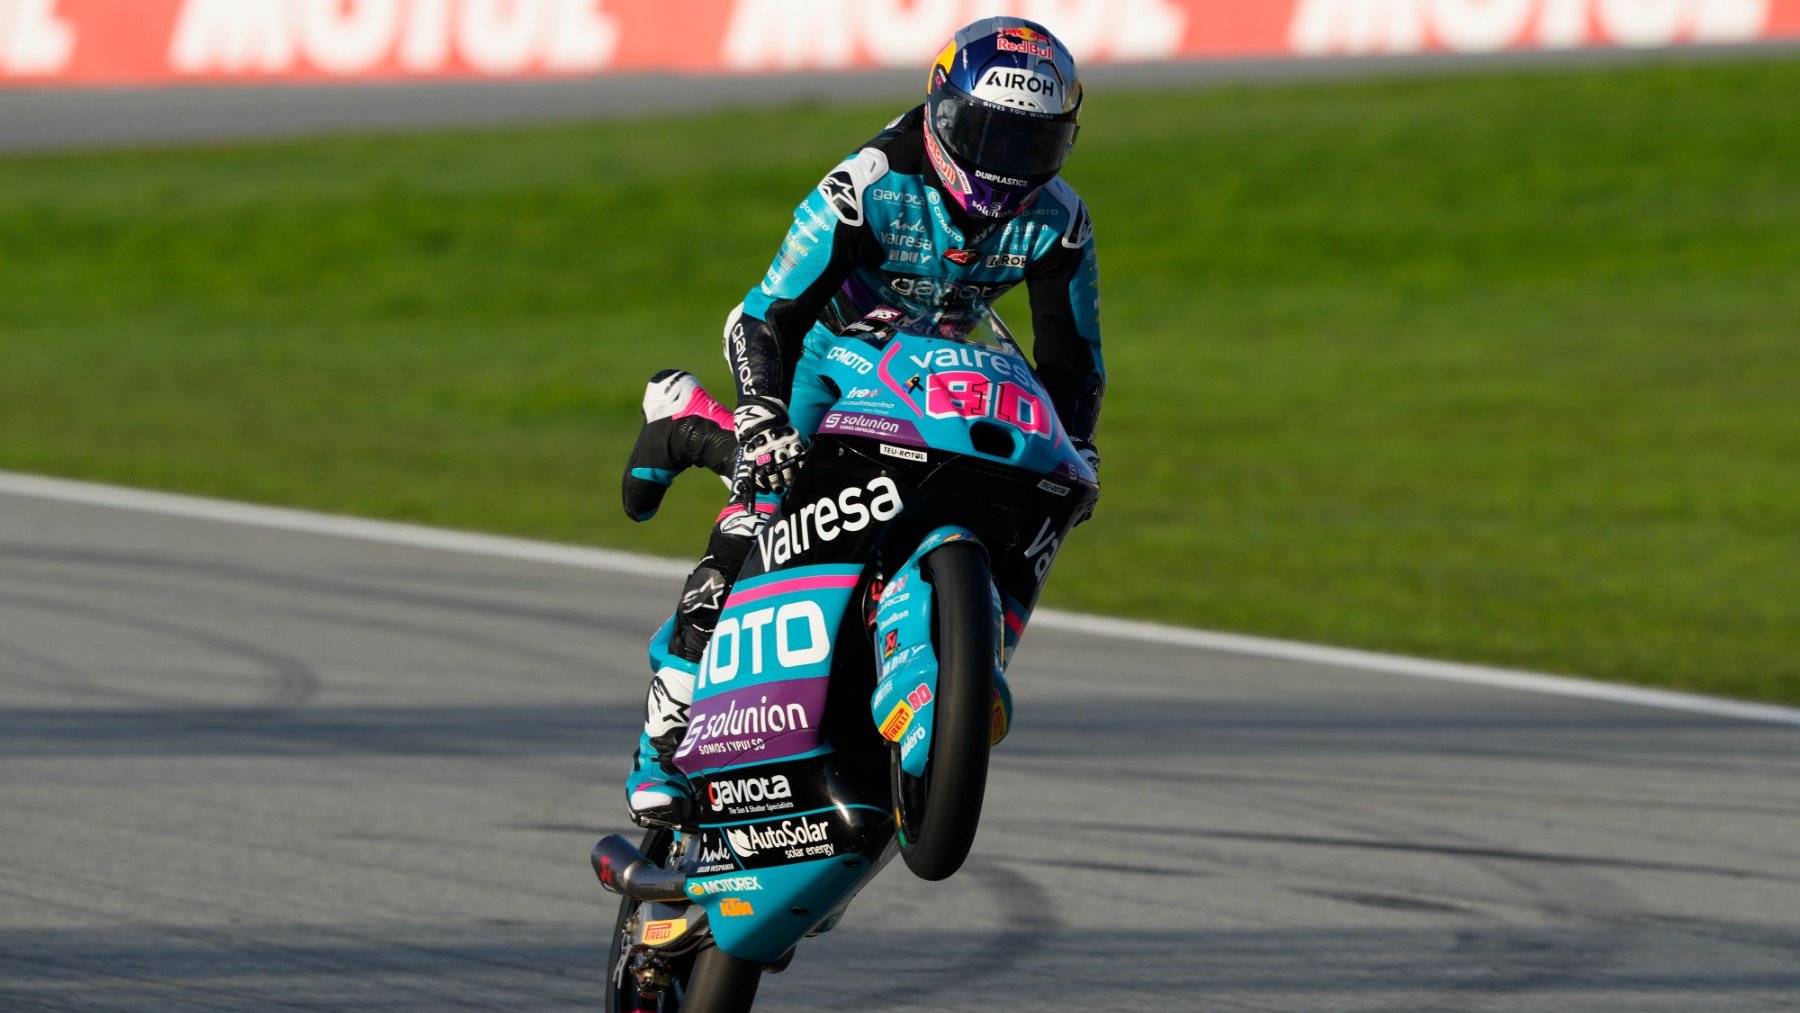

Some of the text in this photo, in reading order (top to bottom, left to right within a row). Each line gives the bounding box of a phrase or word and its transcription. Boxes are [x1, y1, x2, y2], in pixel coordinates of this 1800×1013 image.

[997, 38, 1054, 60] Red Bull
[986, 71, 1054, 97] AIROH
[983, 101, 1054, 120] GIVES YOU WINGS
[975, 169, 1028, 187] DURPLASTICS
[827, 346, 874, 375] CFMOTO
[926, 371, 1052, 440] 80
[841, 415, 899, 433] solunion
[758, 476, 904, 573] valresa
[700, 696, 809, 741] solunion
[882, 708, 910, 740] PIRELLI
[698, 742, 726, 755] SOMOS
[708, 774, 792, 812] gaviota
[728, 806, 737, 815] The
[749, 804, 766, 813] Shutter
[749, 817, 828, 851] AutoSolar
[785, 843, 835, 858] solar energy
[702, 876, 763, 895] MOTOREX
[719, 898, 754, 916] KTM
[645, 922, 672, 940] PIRELLI
